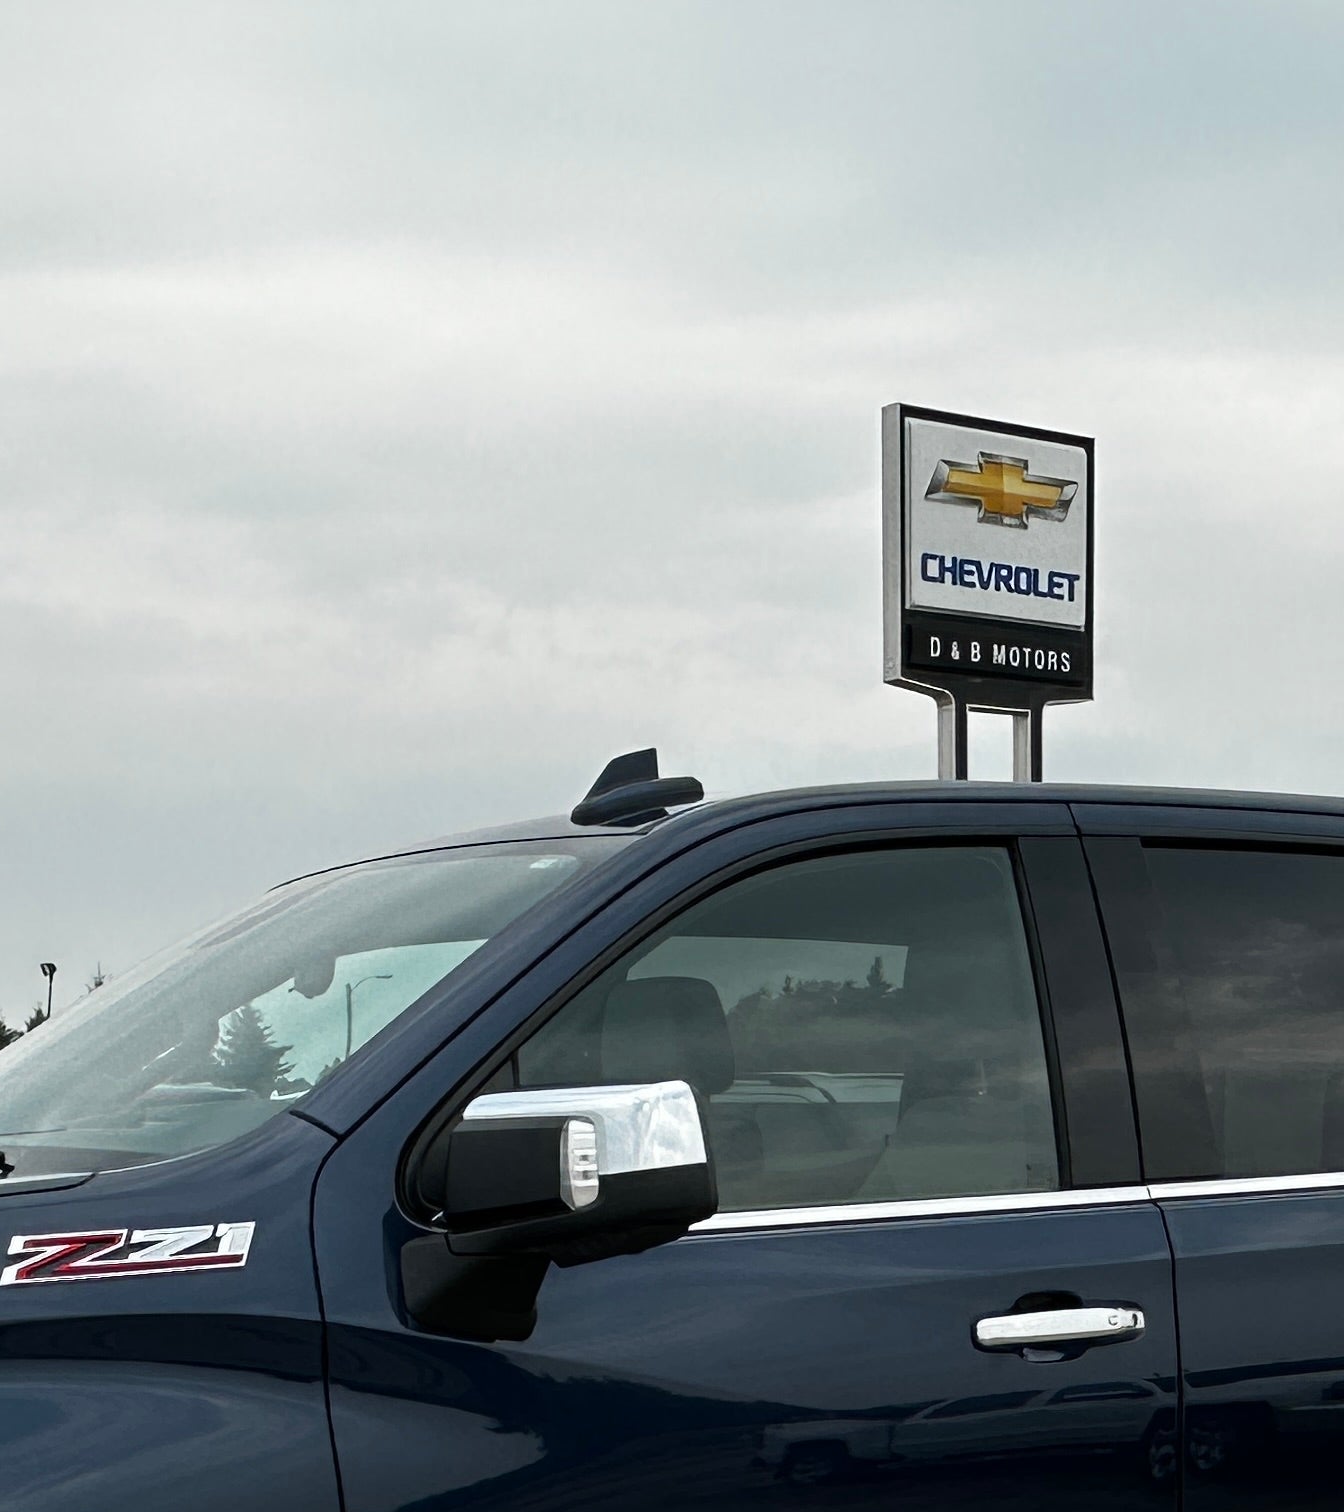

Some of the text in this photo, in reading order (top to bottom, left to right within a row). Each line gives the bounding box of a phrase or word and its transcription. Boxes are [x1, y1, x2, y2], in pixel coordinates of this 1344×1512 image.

[920, 552, 1081, 602] CHEVROLET
[930, 636, 1072, 673] D & B MOTORS
